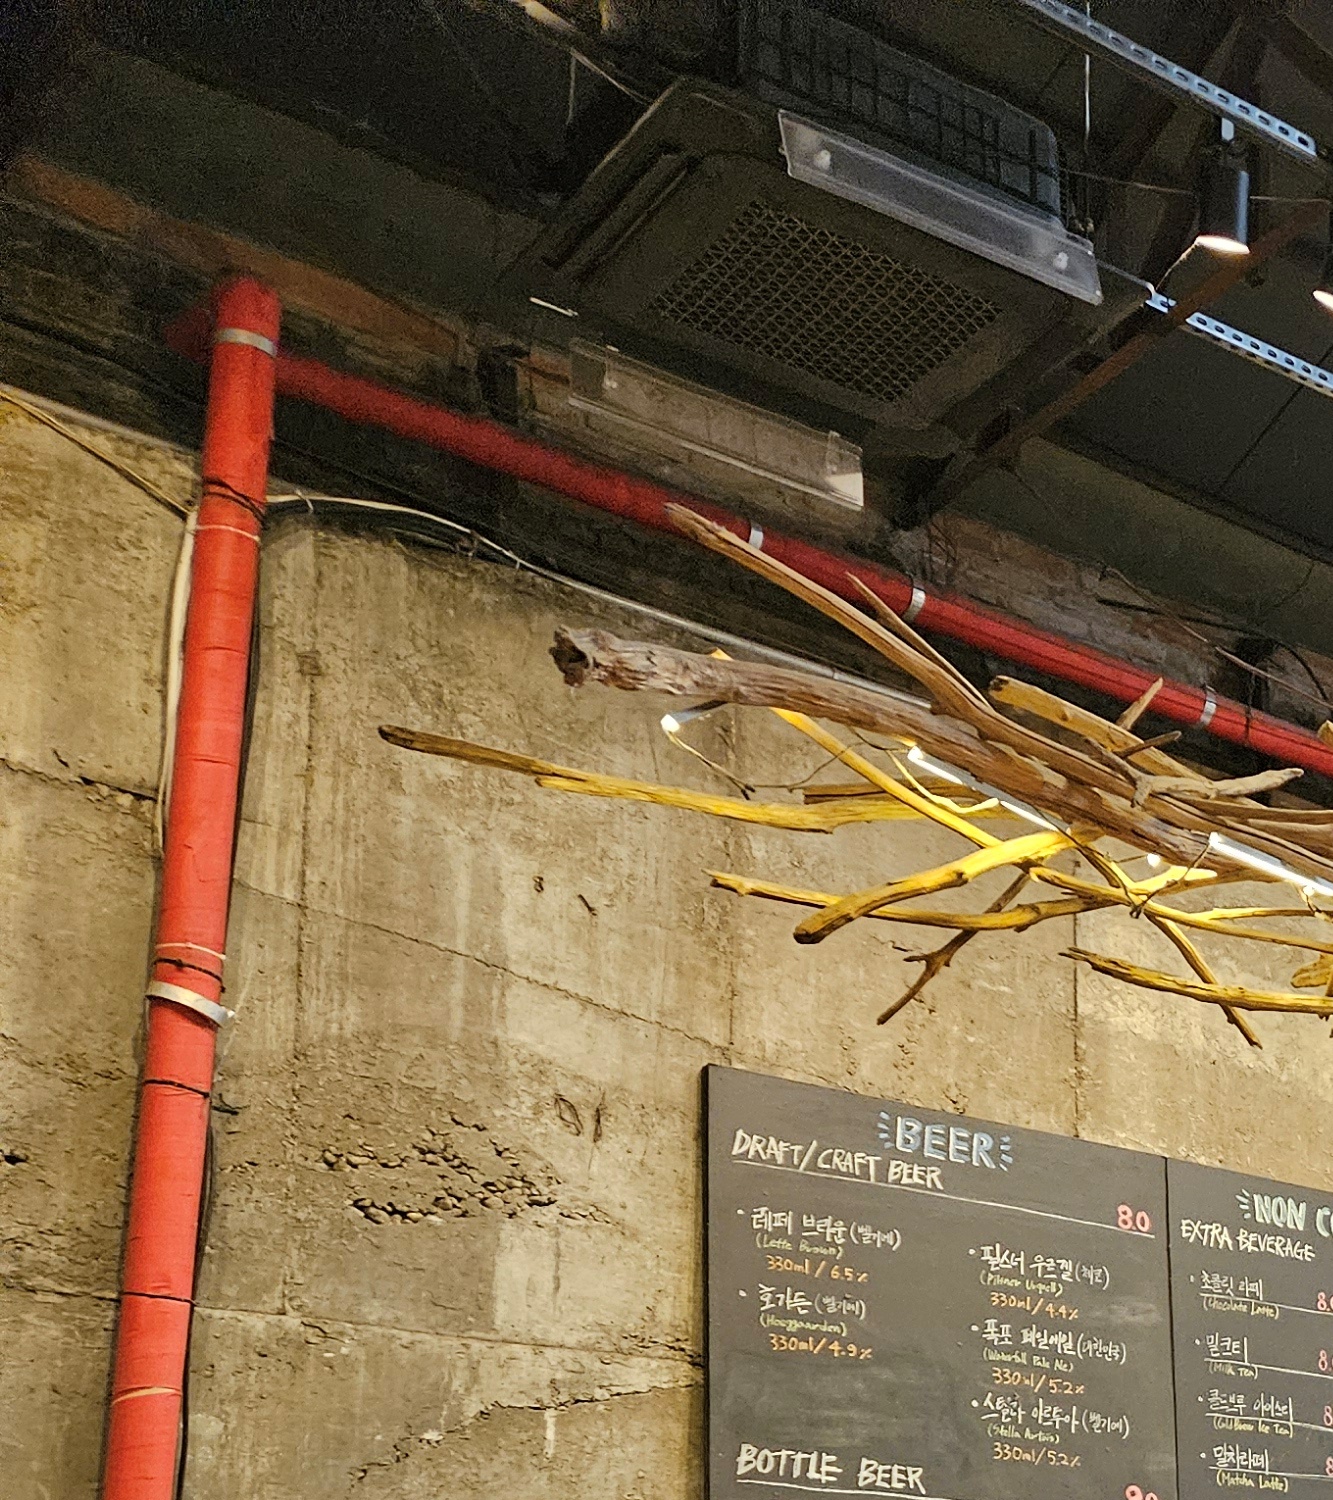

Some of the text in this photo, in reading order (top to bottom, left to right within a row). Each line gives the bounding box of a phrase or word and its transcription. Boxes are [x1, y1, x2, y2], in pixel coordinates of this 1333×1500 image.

[895, 1114, 995, 1169] BEER
[888, 1159, 943, 1189] BEER
[752, 1207, 793, 1235] 레페
[1117, 1204, 1151, 1232] 8.0
[1253, 1194, 1306, 1230] NON
[1181, 1219, 1315, 1262] EXTRA BEVERAGE
[981, 1243, 1024, 1275] 필스너
[982, 1319, 1012, 1345] 폭포
[1033, 1355, 1050, 1369] Pale
[1206, 1332, 1248, 1363] 밀크티
[736, 1443, 926, 1494] BOTTLE BEER
[1217, 1469, 1254, 1487] (Matcha
